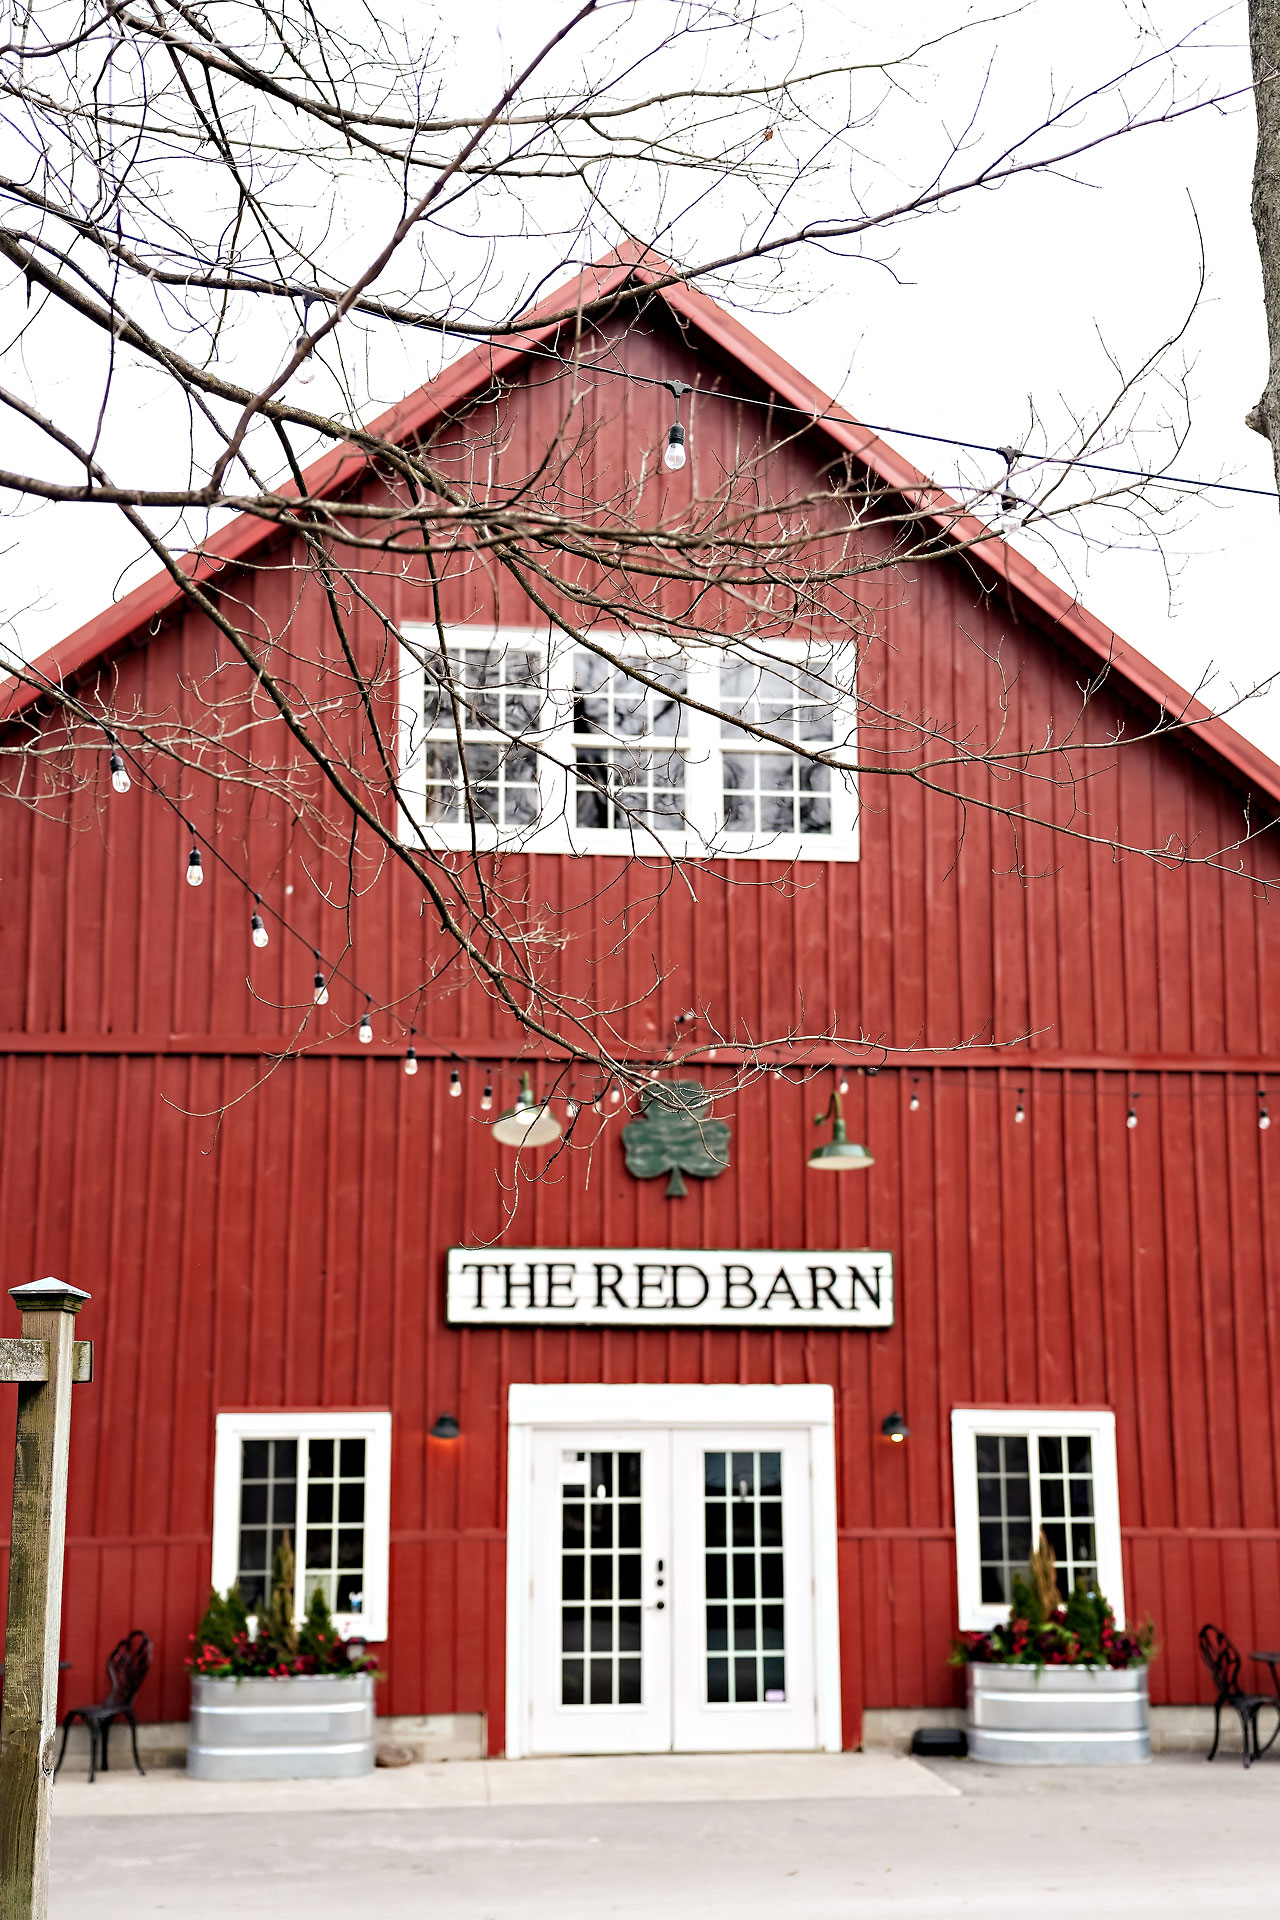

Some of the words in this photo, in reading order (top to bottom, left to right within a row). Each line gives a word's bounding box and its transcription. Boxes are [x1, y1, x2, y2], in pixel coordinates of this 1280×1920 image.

[462, 1263, 577, 1309] THE
[593, 1263, 710, 1309] RED
[721, 1265, 884, 1310] BARN
